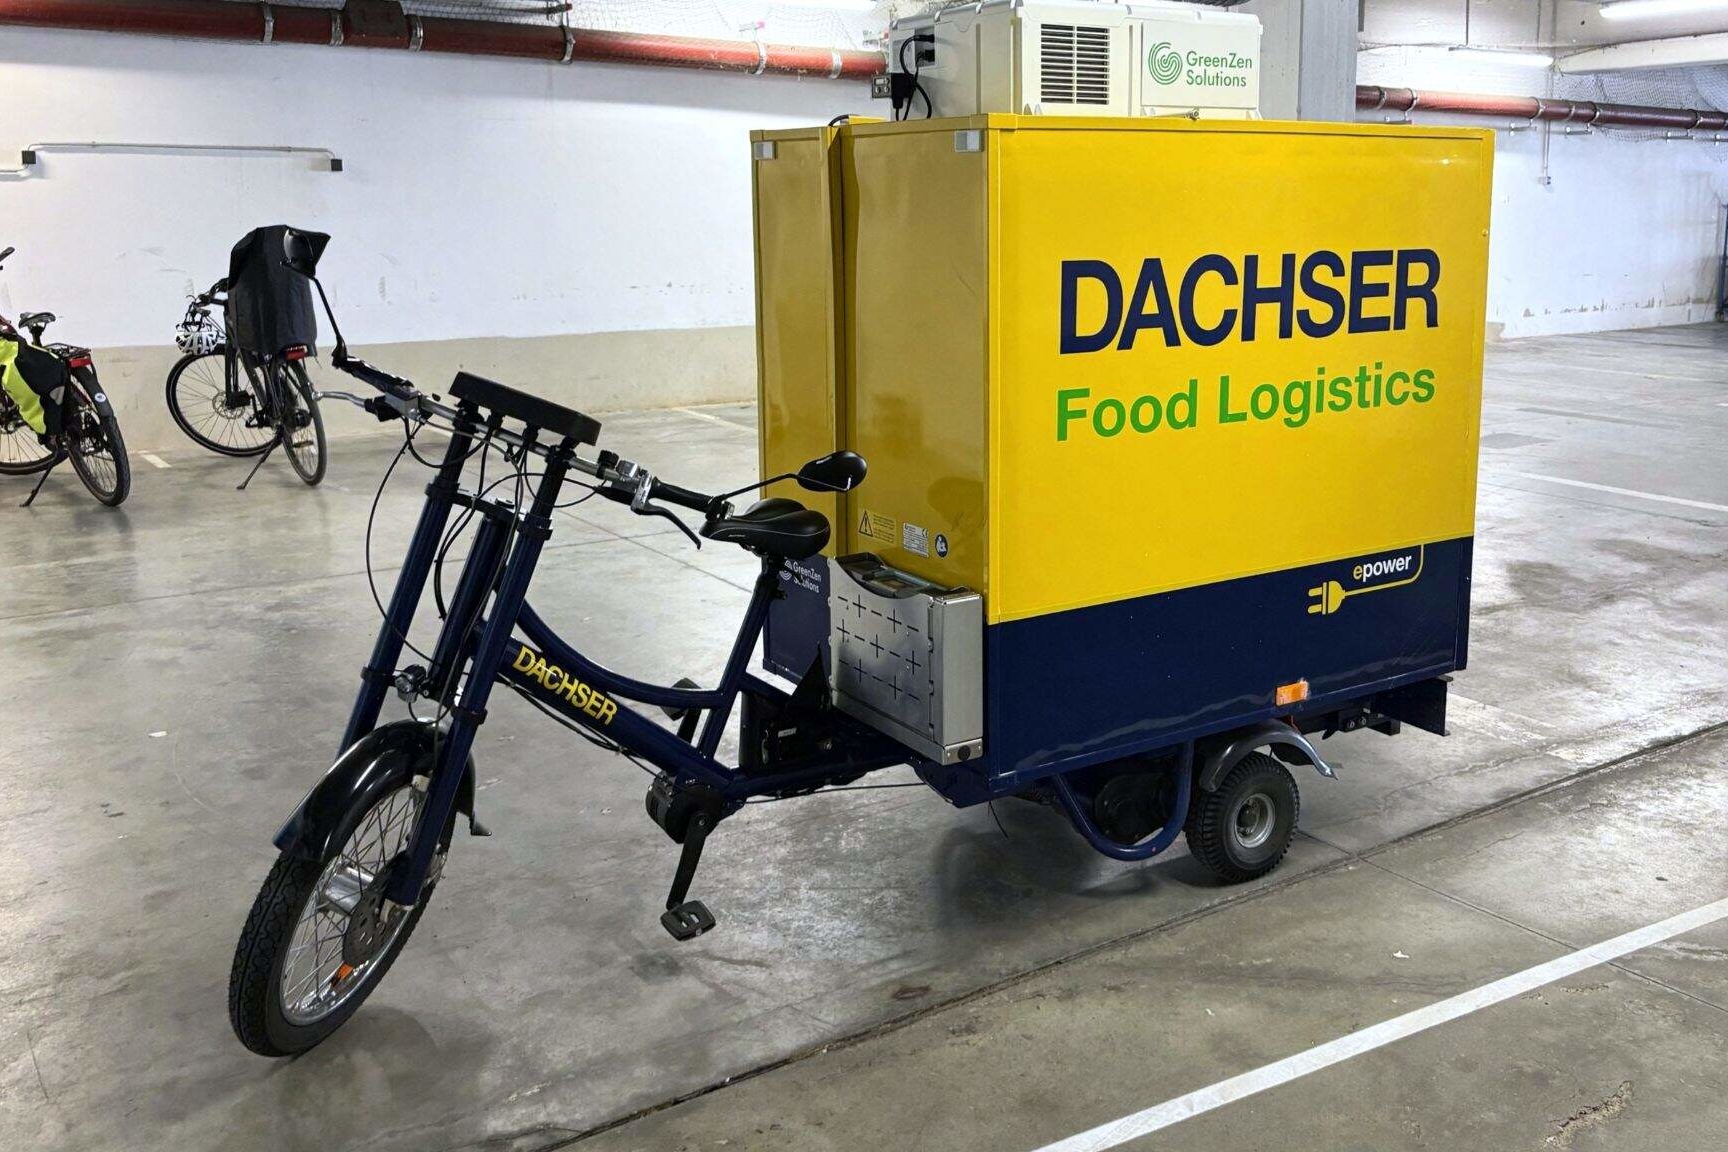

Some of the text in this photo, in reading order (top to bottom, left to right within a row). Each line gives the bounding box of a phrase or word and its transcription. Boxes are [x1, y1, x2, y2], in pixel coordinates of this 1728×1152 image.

[1186, 50, 1253, 69] GreenZen
[1186, 69, 1247, 87] Solutions
[1059, 248, 1441, 355] DACHSER
[1057, 361, 1436, 441] Food Logistics
[1353, 555, 1412, 583] epower
[793, 575, 820, 593] Sutions
[511, 645, 618, 726] DACHSER
